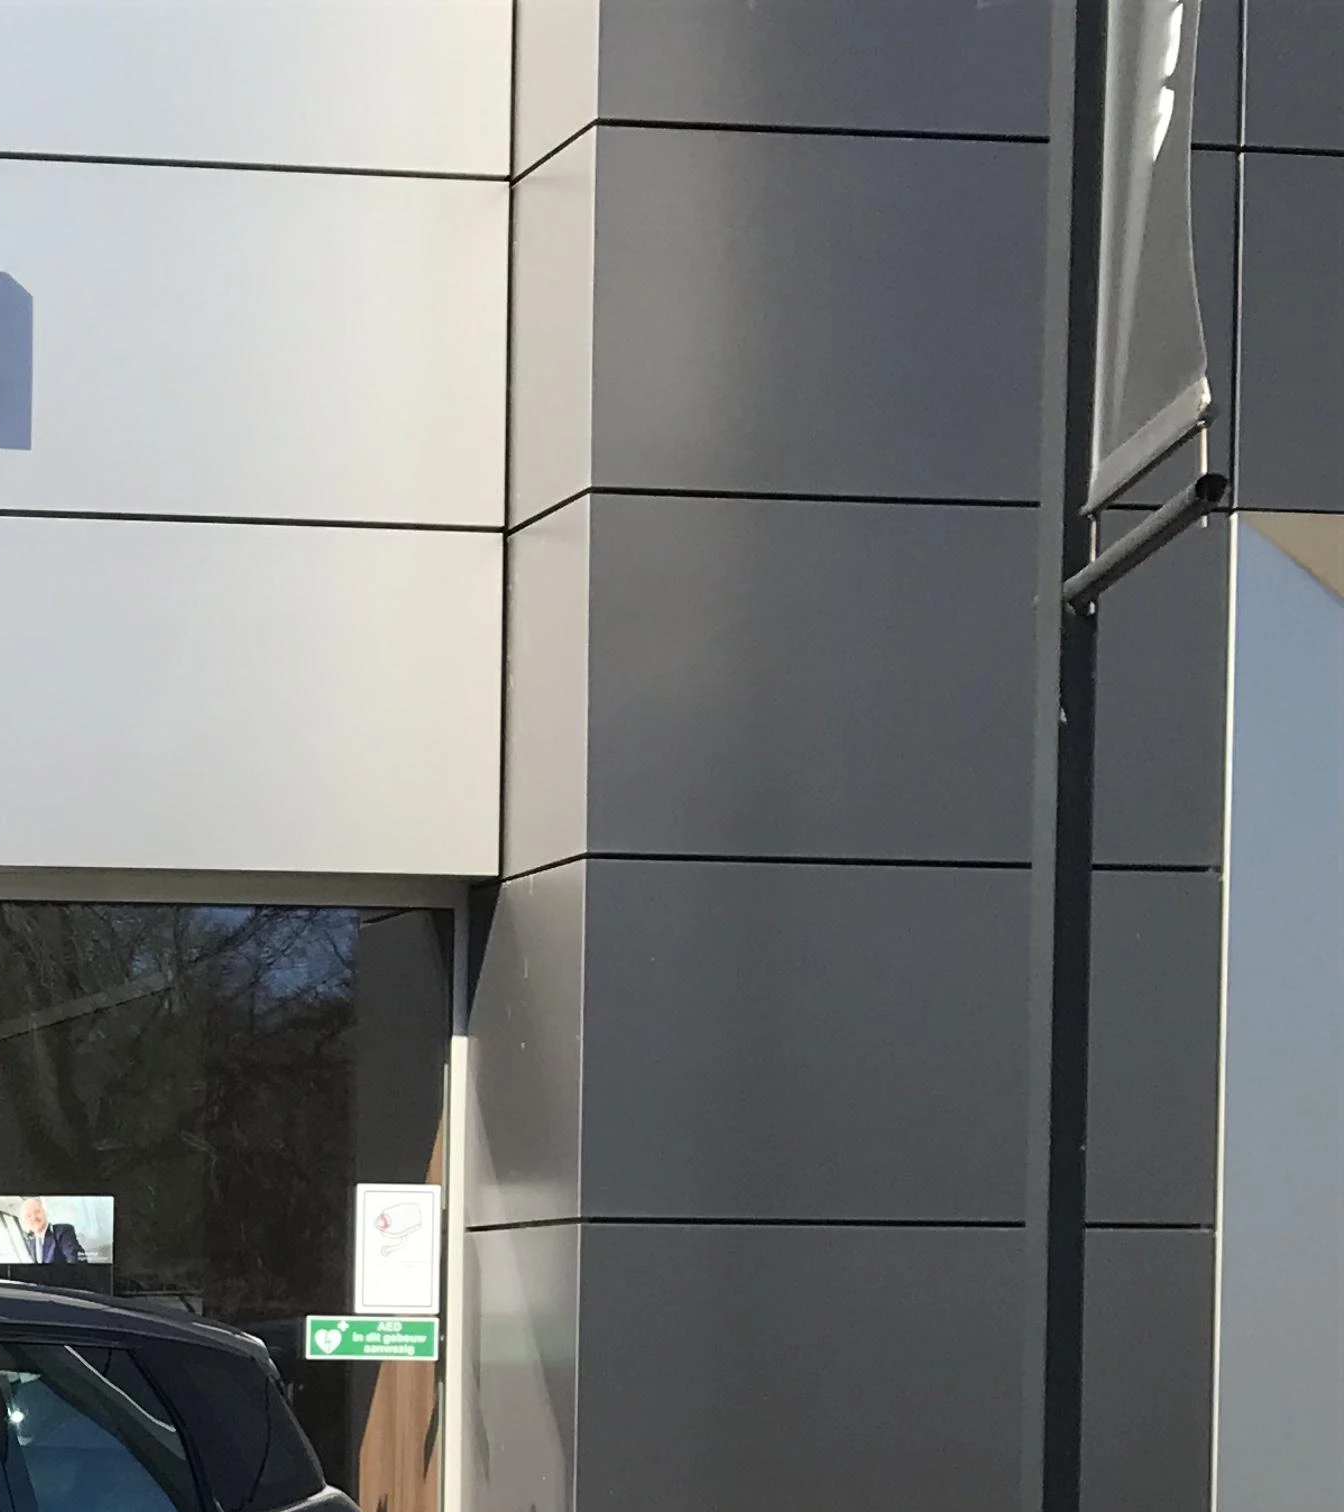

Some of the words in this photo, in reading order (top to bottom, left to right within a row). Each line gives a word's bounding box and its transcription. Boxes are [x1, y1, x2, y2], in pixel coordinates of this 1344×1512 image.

[377, 1321, 403, 1332] AED
[352, 1331, 364, 1342] in
[365, 1332, 382, 1343] dit
[383, 1333, 427, 1345] gebouw
